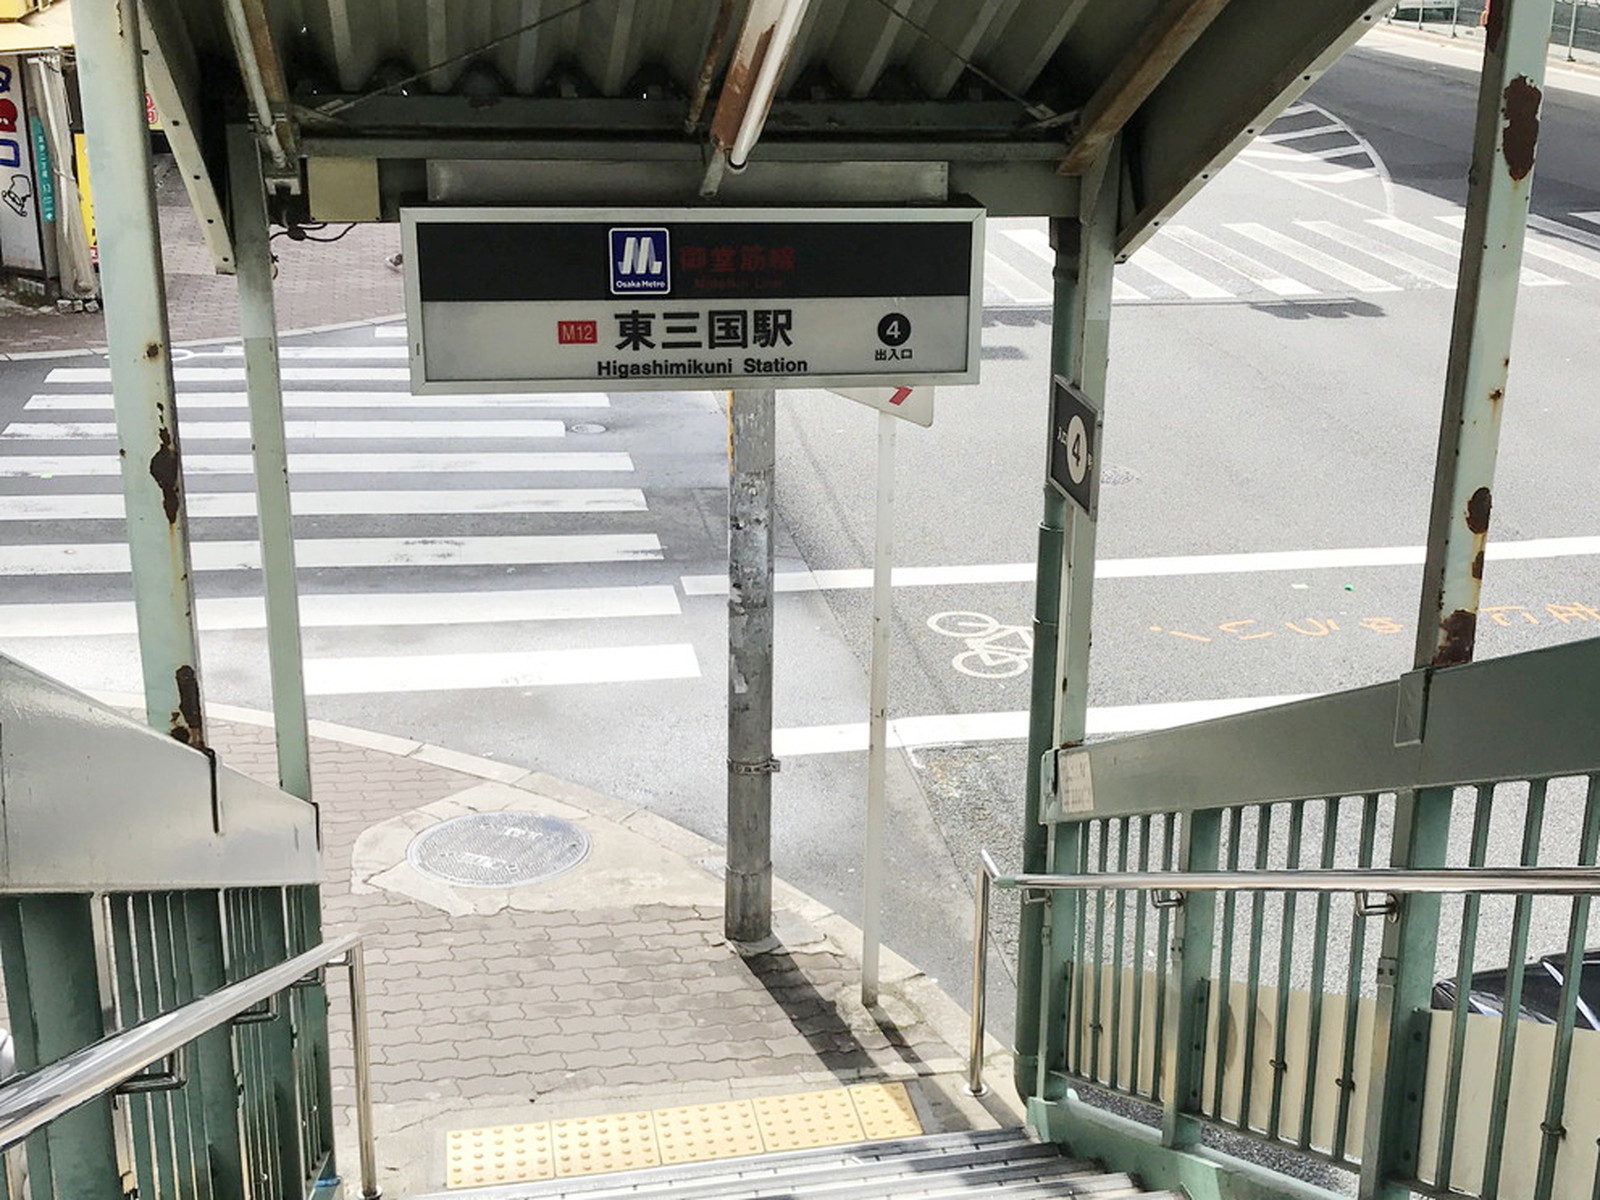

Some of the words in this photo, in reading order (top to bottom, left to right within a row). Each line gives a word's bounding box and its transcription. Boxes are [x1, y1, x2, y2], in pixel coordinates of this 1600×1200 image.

[616, 280, 641, 289] Osaka
[642, 280, 666, 289] Metro
[561, 325, 594, 341] M12
[613, 309, 793, 351] 東三国駅
[885, 320, 901, 339] 4
[874, 348, 913, 361] 出入口
[597, 358, 733, 379] Higashimikuni
[743, 357, 808, 374] Station
